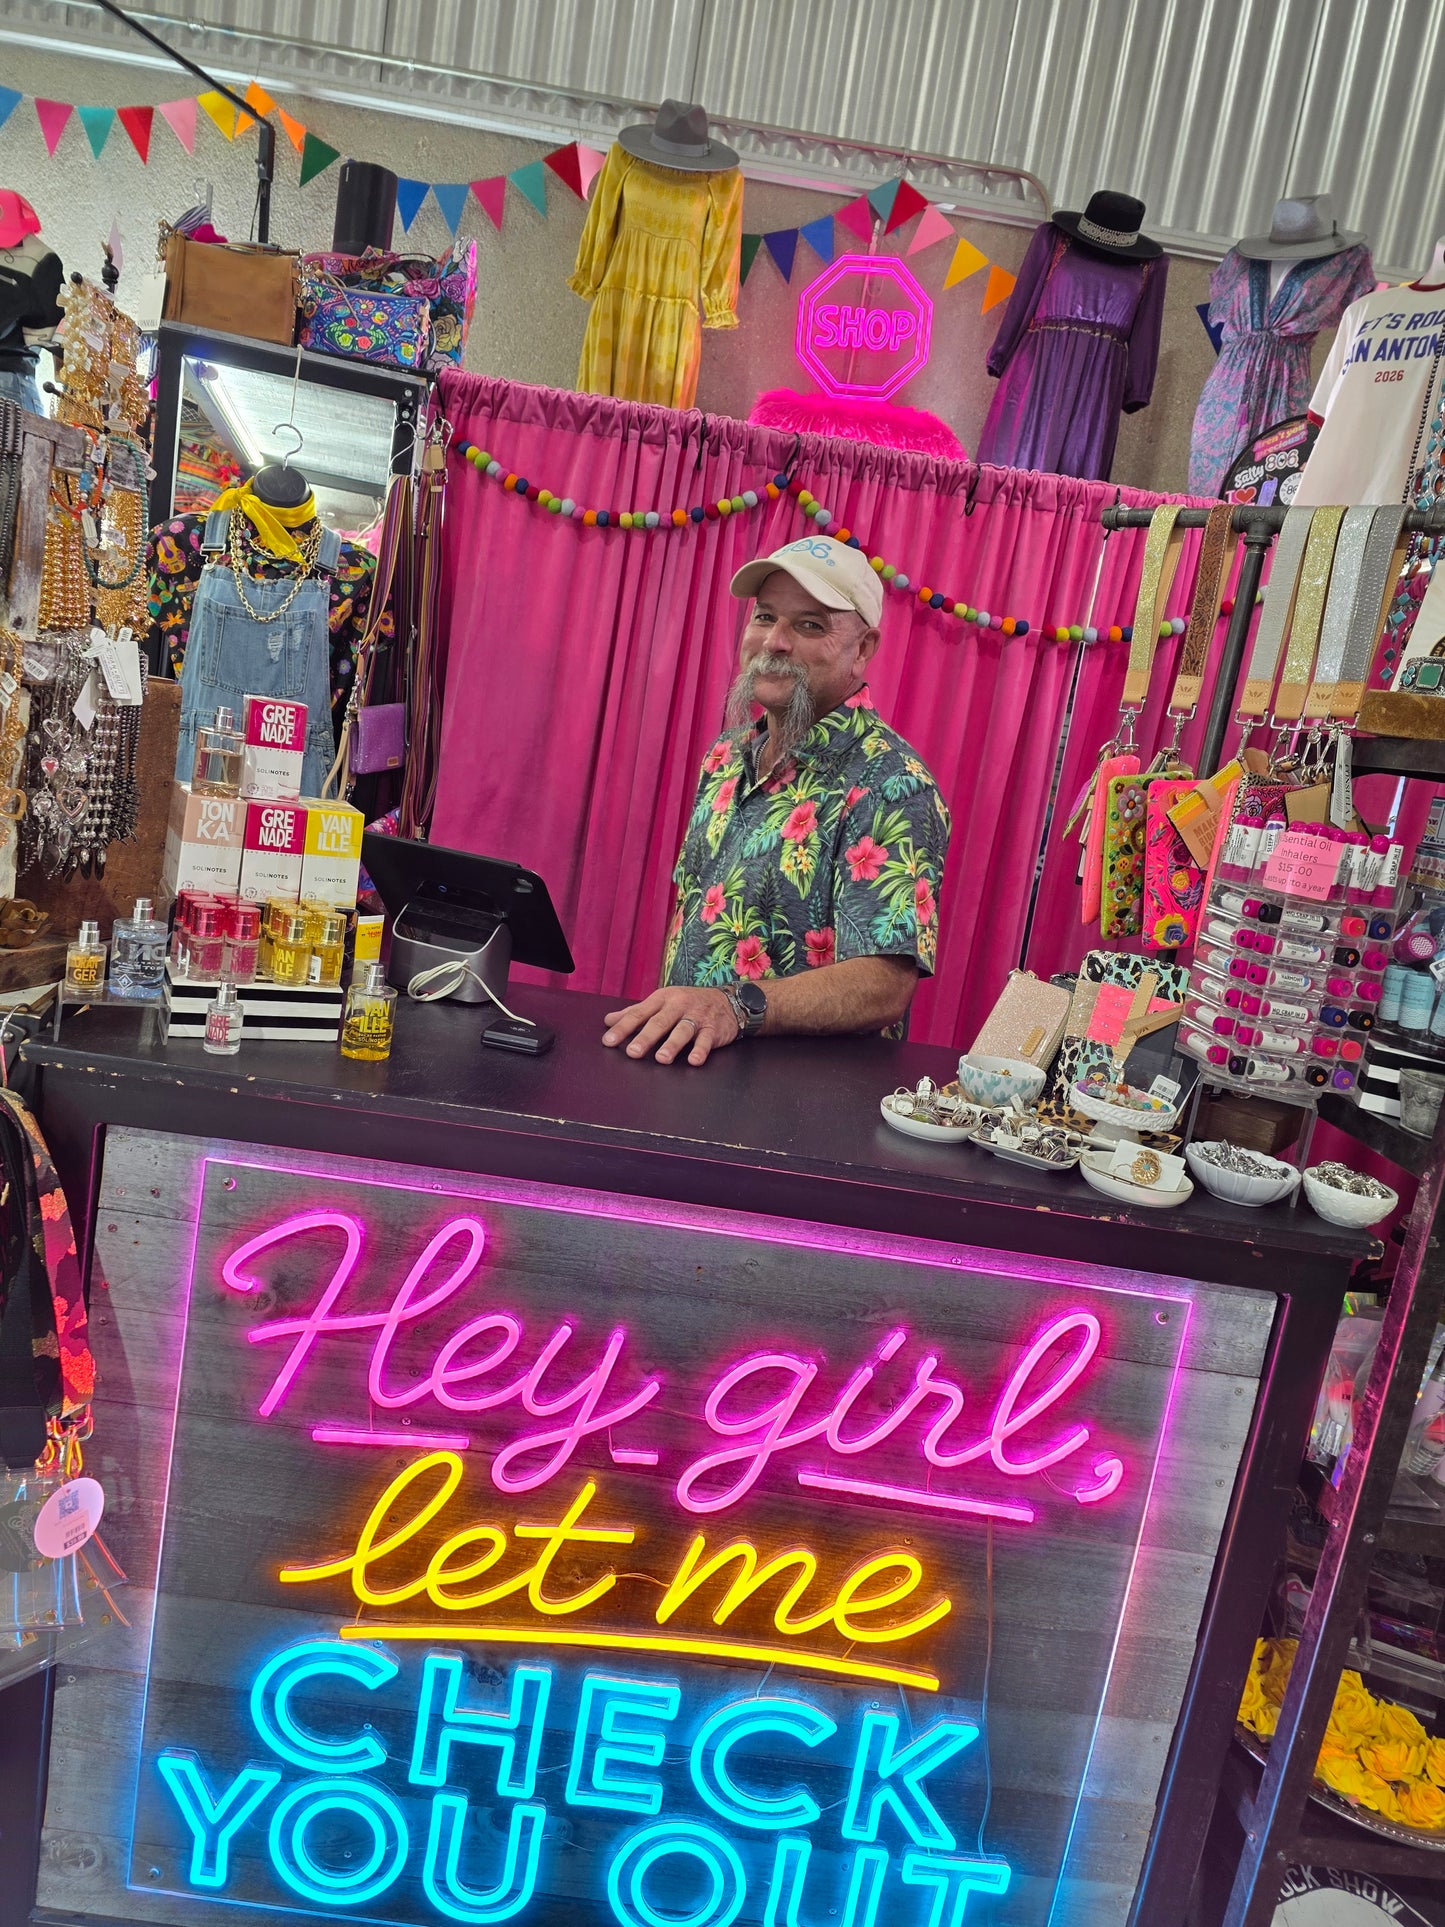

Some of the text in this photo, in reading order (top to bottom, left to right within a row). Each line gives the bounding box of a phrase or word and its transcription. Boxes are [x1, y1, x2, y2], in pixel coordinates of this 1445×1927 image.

[814, 304, 917, 351] SHOP
[1374, 369, 1405, 383] 2026
[1265, 450, 1299, 472] 806
[1234, 465, 1265, 489] Salty
[262, 703, 296, 726] GRE
[260, 722, 295, 745] NADE
[256, 767, 290, 777] SOLINOTES
[200, 799, 235, 823] TON
[261, 808, 295, 830] GRE
[196, 818, 230, 841] KA
[320, 813, 353, 835] VAN
[258, 828, 293, 849] NADE
[317, 831, 351, 853] ILLE
[1267, 833, 1275, 853] SLEEPY
[1320, 840, 1332, 852] Oil
[192, 864, 227, 873] SOLINOTES
[255, 871, 289, 880] SOLINOTES
[314, 876, 347, 884] SOLINOTES
[1307, 883, 1326, 893] year
[73, 968, 97, 981] GER
[365, 1000, 390, 1017] VAN
[1282, 1009, 1294, 1017] CRAP
[209, 1014, 231, 1028] GRE
[359, 1016, 389, 1034] ILLE
[207, 1026, 229, 1041] NADE
[221, 1210, 1124, 1513] Hey girl,
[279, 1450, 952, 1643] let me
[250, 1640, 980, 1851] CHECK
[157, 1748, 1010, 1927] YOU OUT
[1326, 1866, 1405, 1916] SHOW
